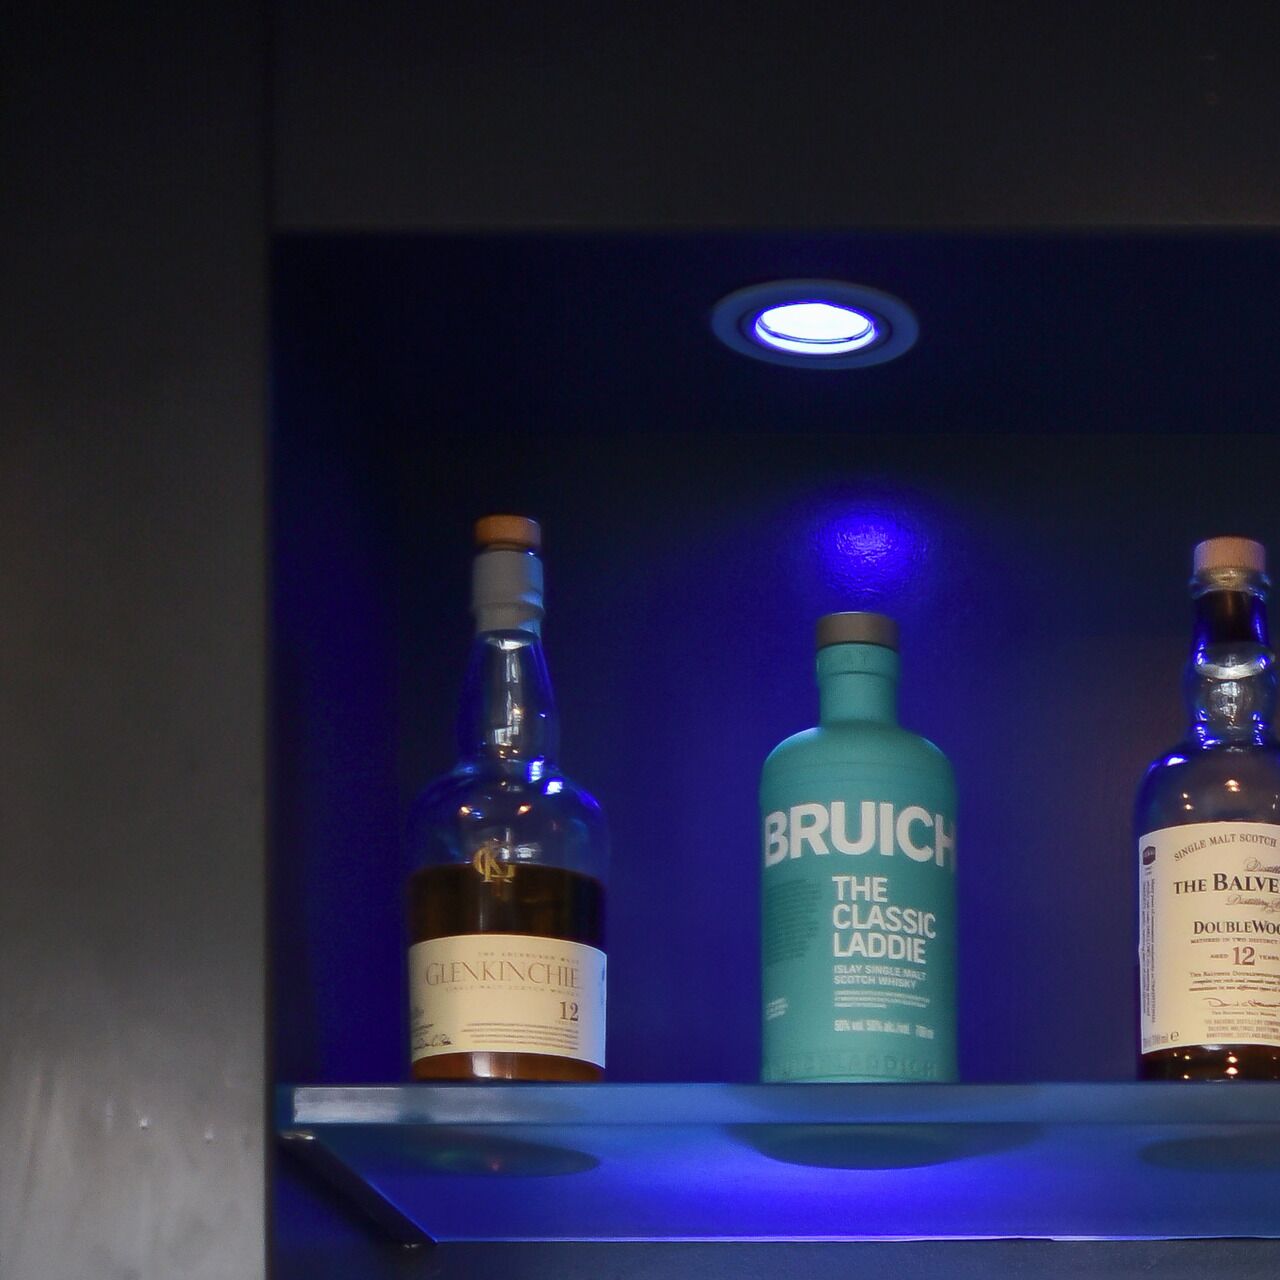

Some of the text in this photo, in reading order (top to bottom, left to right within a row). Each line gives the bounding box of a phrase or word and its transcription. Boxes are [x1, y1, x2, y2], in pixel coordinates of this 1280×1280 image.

[1173, 839, 1207, 862] SINGLE
[1209, 833, 1237, 847] MALT
[1239, 833, 1278, 849] SCOTCH
[832, 875, 889, 904] THE
[1173, 879, 1208, 895] THE
[833, 903, 936, 939] CLASSIC
[833, 932, 927, 965] LADDIE
[1232, 946, 1256, 966] 12
[425, 960, 583, 990] GLENKINCHIE
[833, 975, 876, 985] SCOTCH
[559, 1001, 580, 1022] 12
